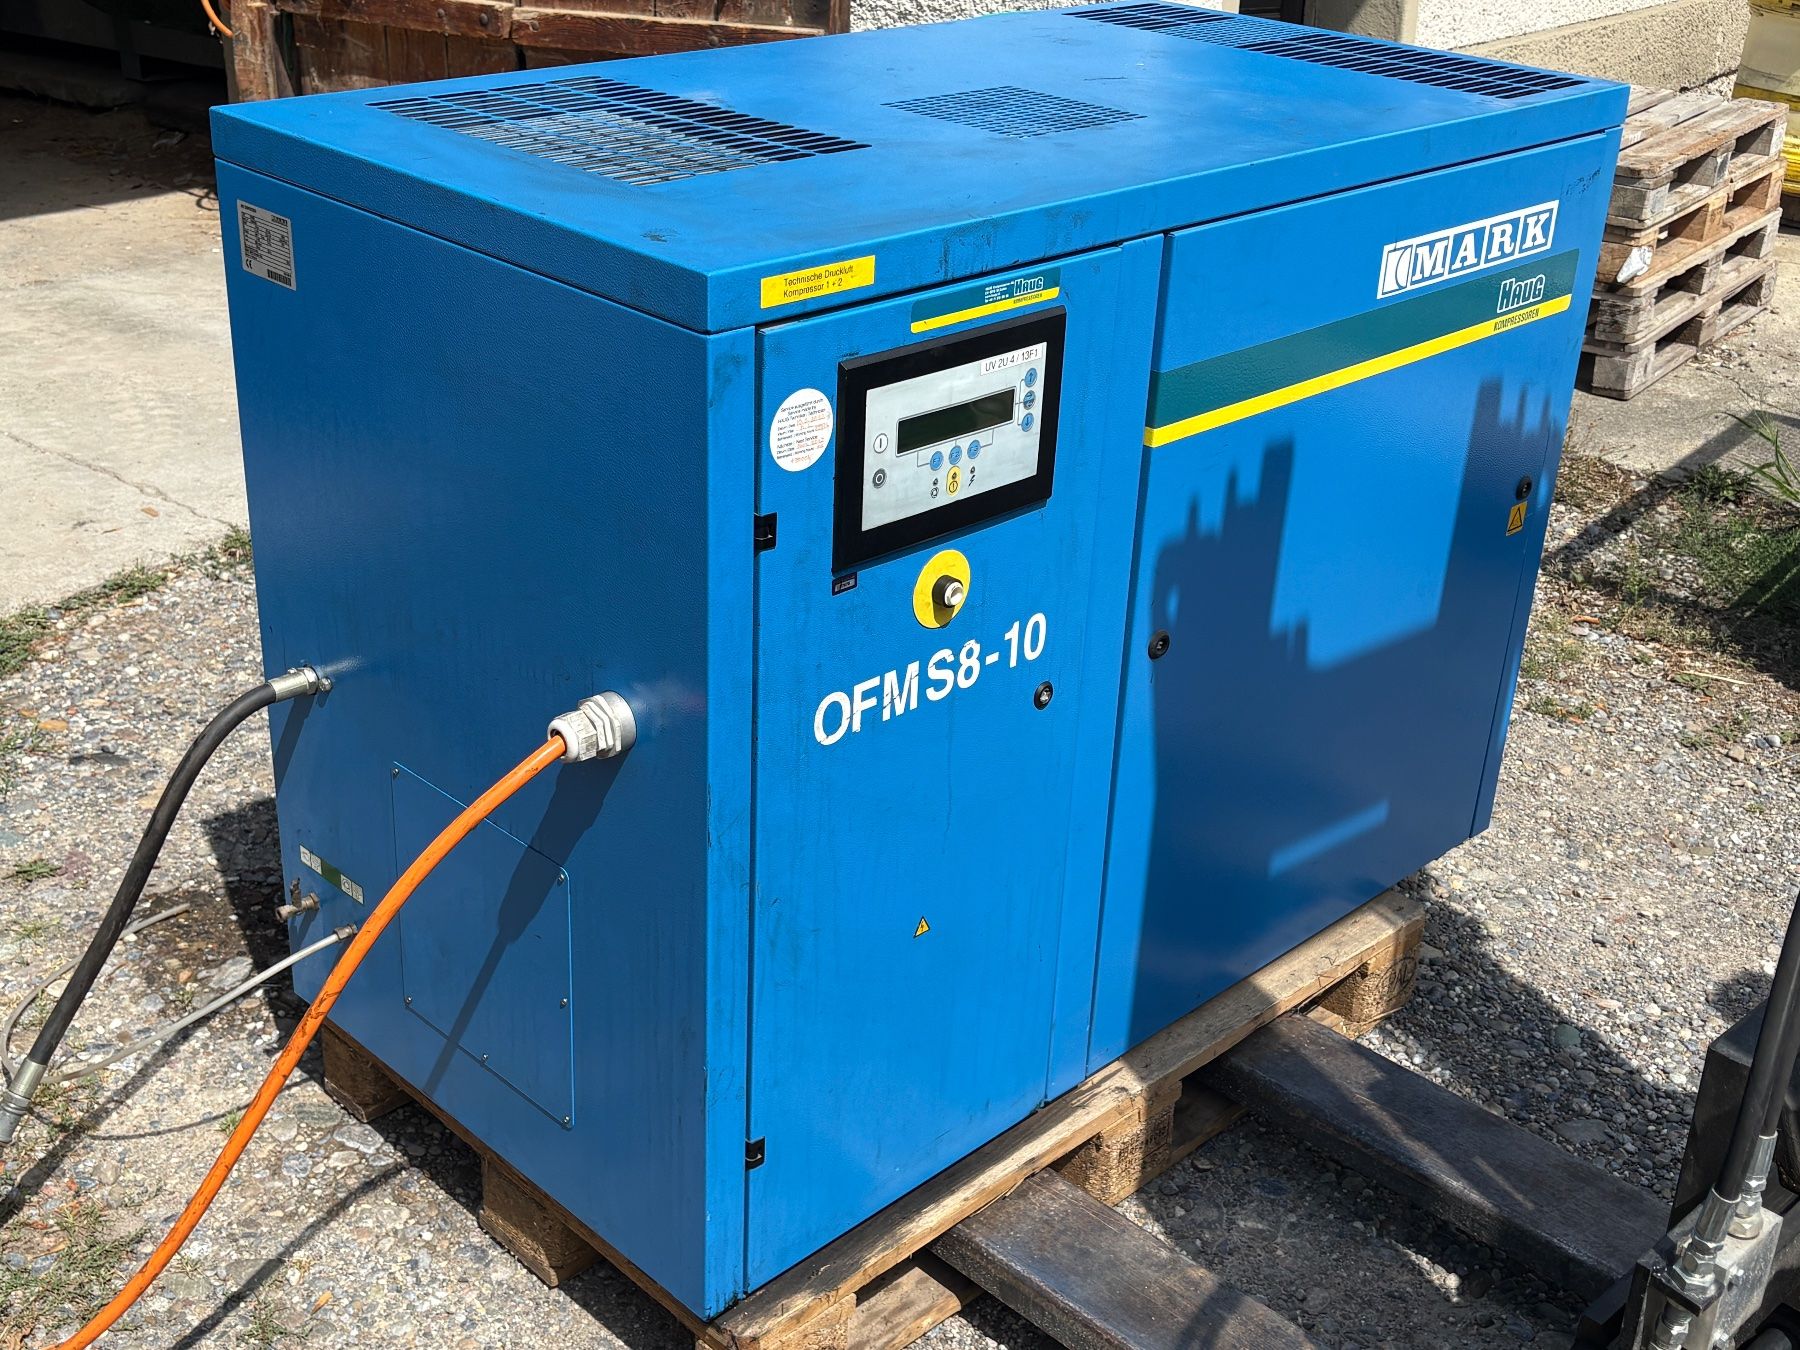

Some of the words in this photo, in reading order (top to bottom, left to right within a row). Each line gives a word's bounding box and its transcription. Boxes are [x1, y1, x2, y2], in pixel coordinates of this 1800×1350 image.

[1411, 211, 1550, 282] MARK
[783, 271, 823, 287] Technische
[824, 265, 854, 279] Druckluft
[783, 283, 825, 298] Kompressor
[837, 278, 843, 287] 2
[1014, 276, 1044, 296] HAUG
[1497, 274, 1545, 313] HAUG
[1493, 308, 1540, 332] KOMPRESSOREN
[985, 360, 996, 372] UV
[1022, 348, 1038, 360] 13F1
